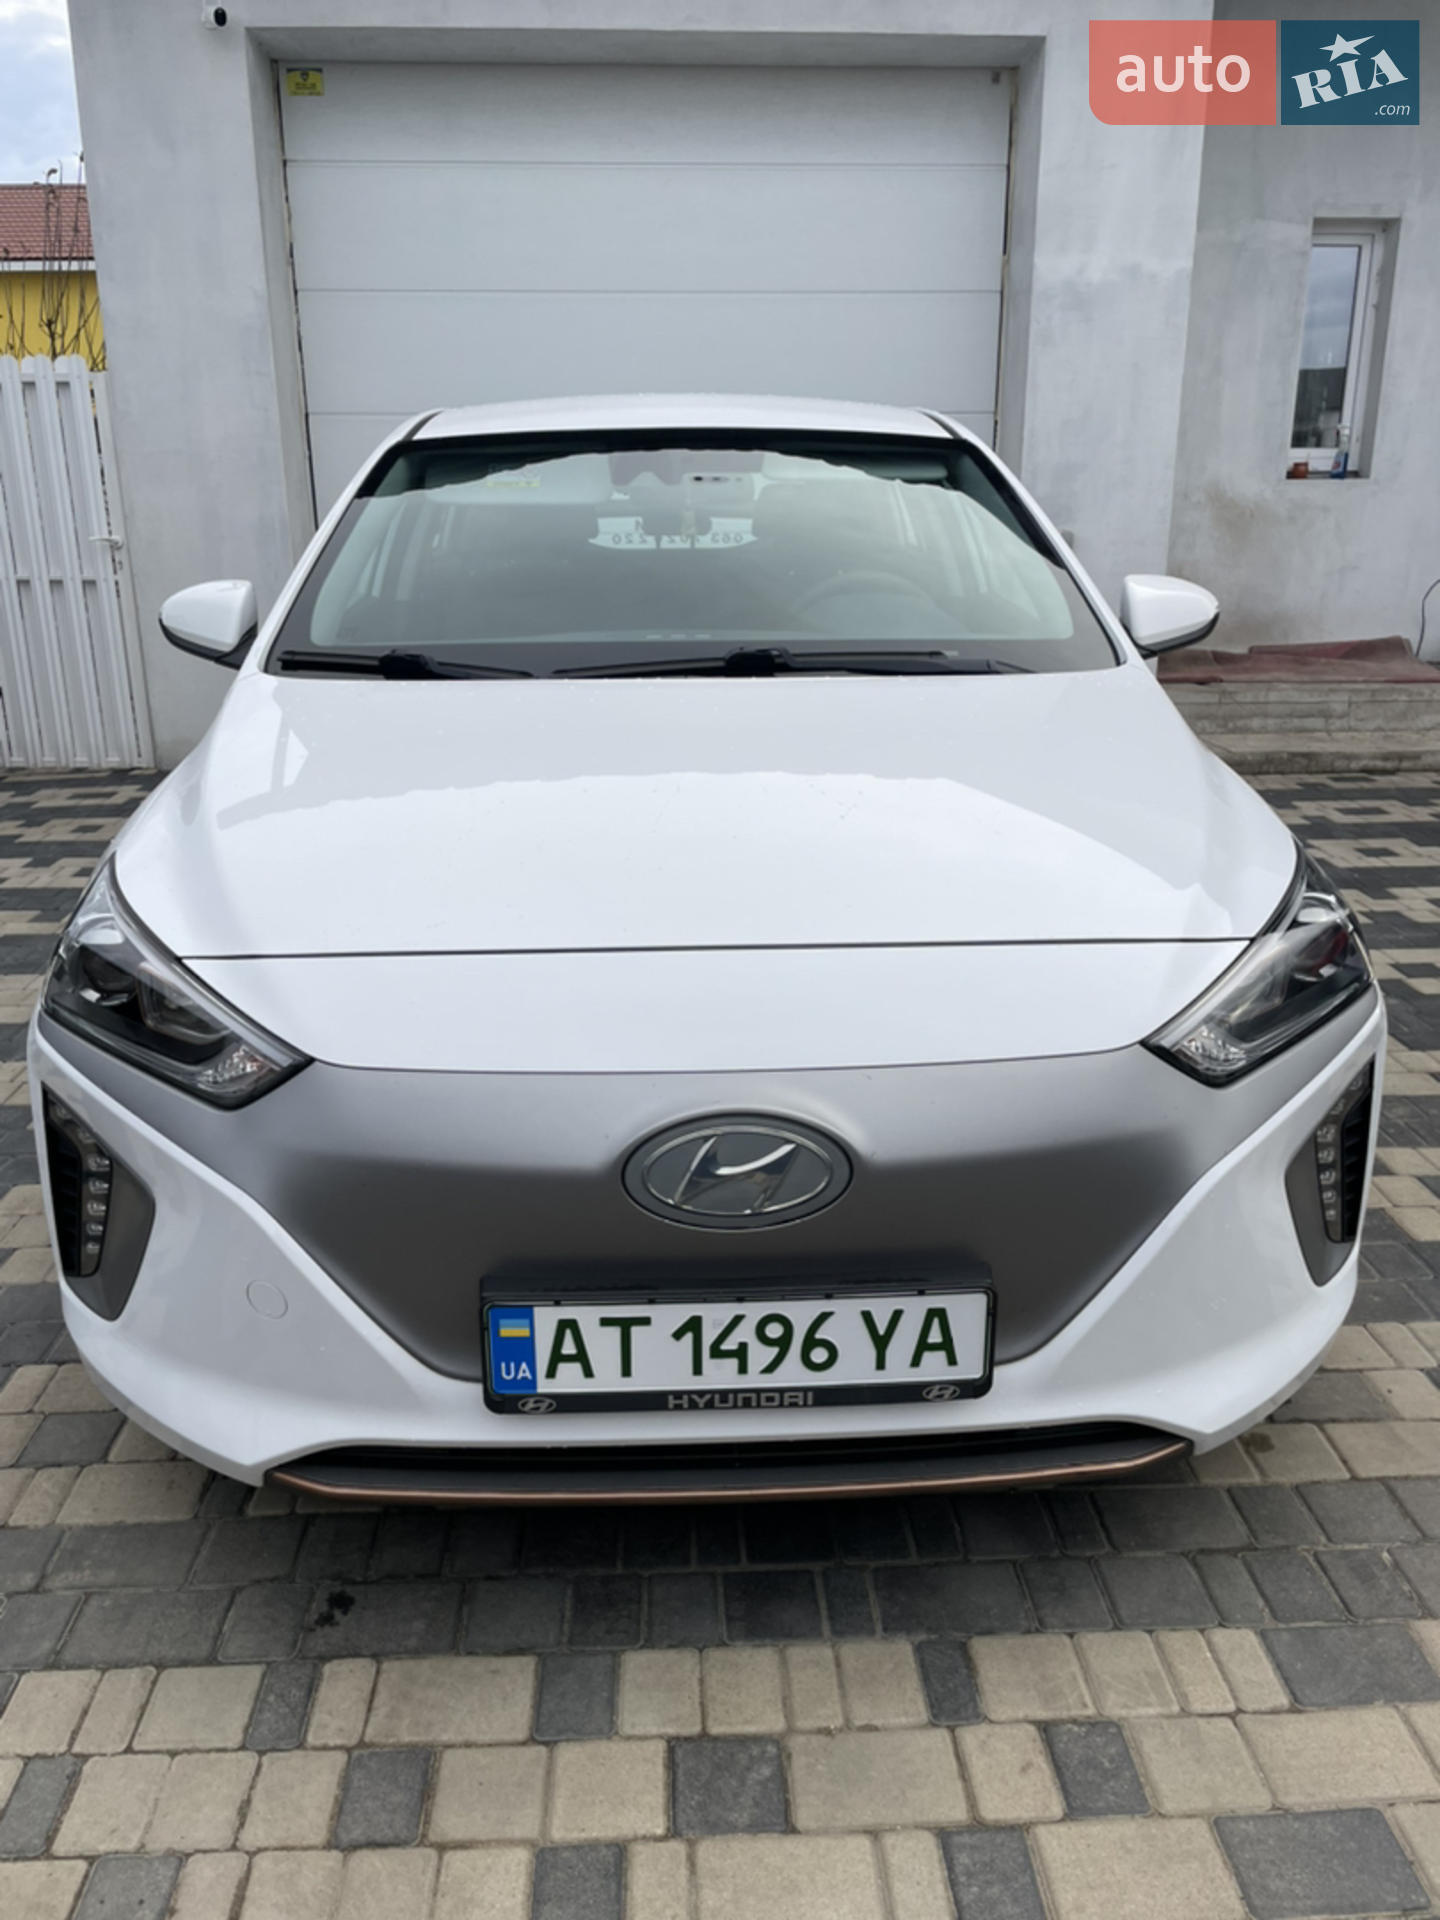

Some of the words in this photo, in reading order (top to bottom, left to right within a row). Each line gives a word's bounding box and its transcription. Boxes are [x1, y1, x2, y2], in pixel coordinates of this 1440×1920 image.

[545, 1315, 652, 1379] AT
[671, 1310, 839, 1376] 1496
[859, 1307, 959, 1371] YA
[501, 1361, 533, 1382] UA
[667, 1391, 814, 1410] HYUNDAI
